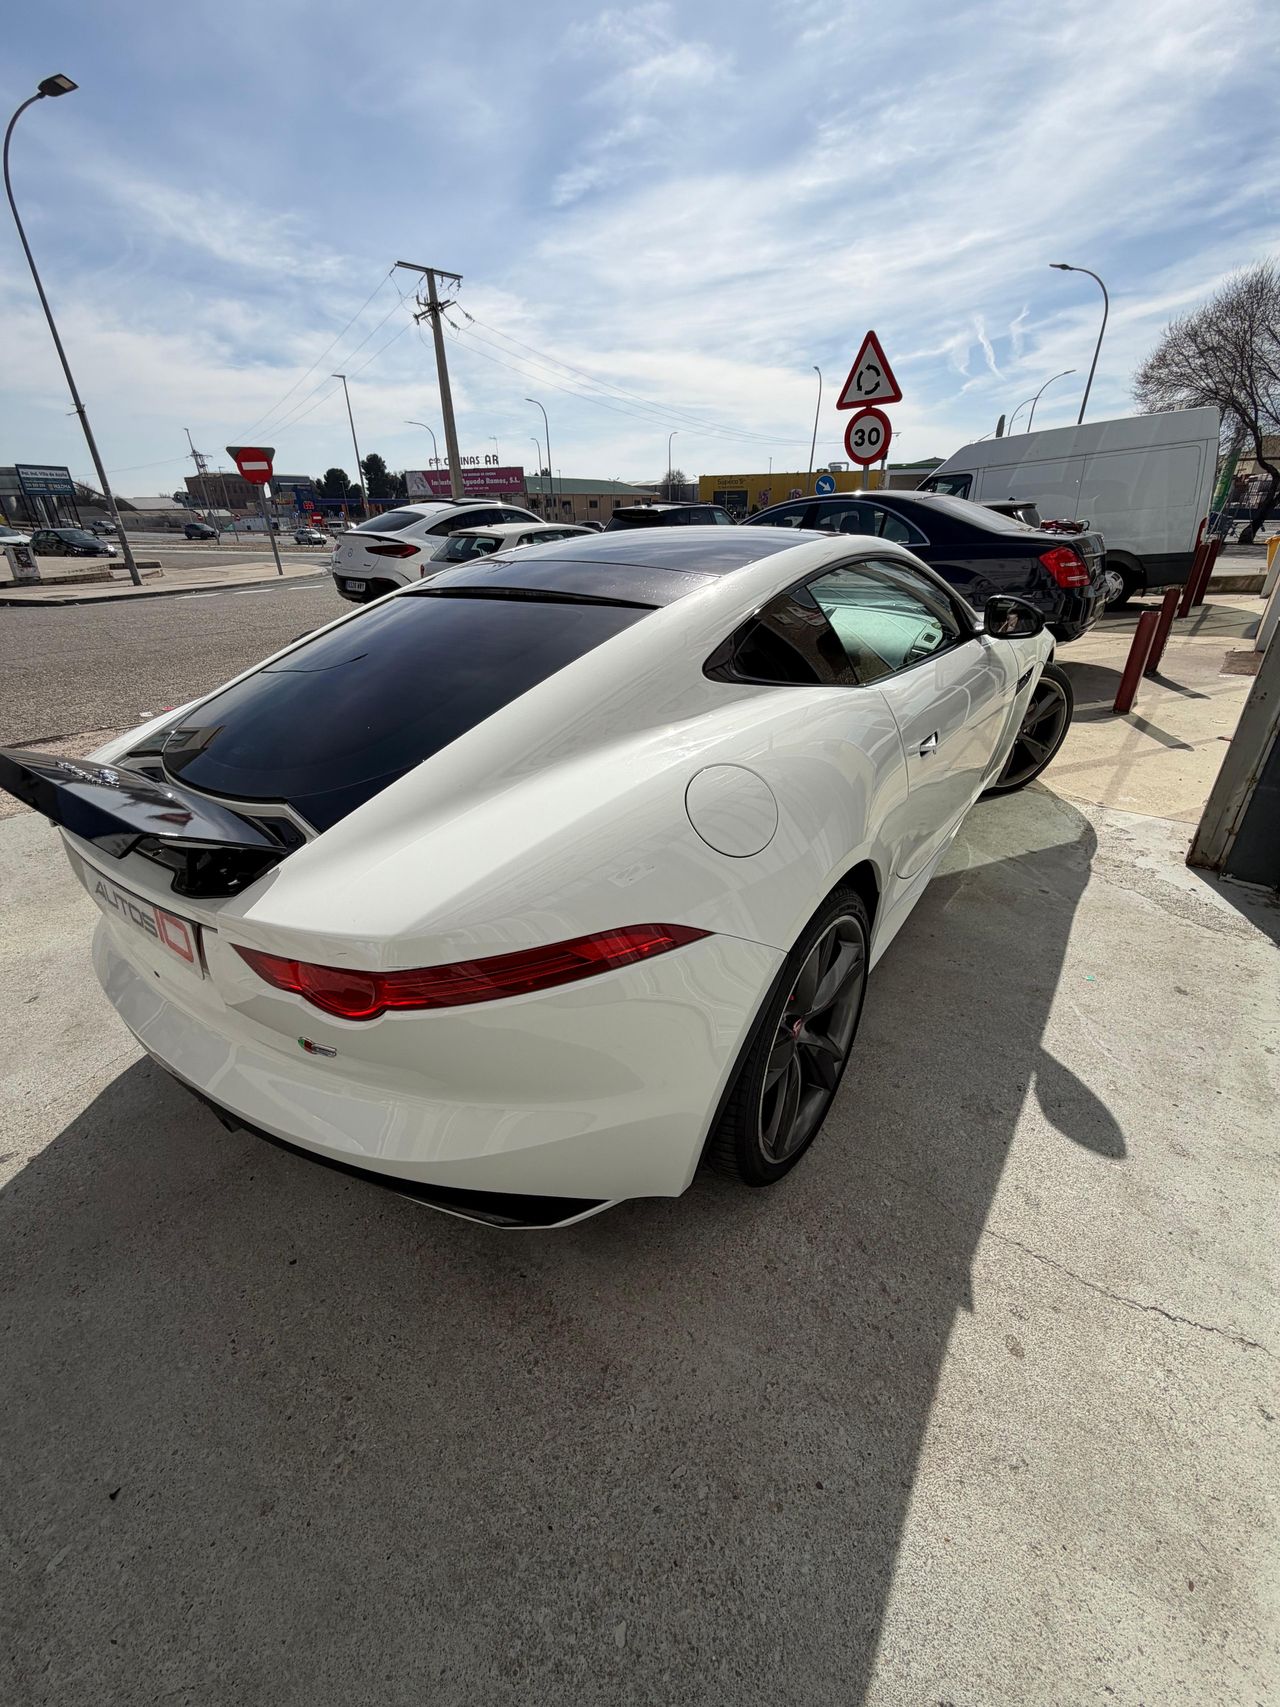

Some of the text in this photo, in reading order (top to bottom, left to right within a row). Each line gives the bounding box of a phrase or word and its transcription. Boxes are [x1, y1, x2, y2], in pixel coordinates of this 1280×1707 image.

[854, 427, 880, 447] 30
[443, 456, 480, 466] CINAS
[485, 455, 499, 465] AR
